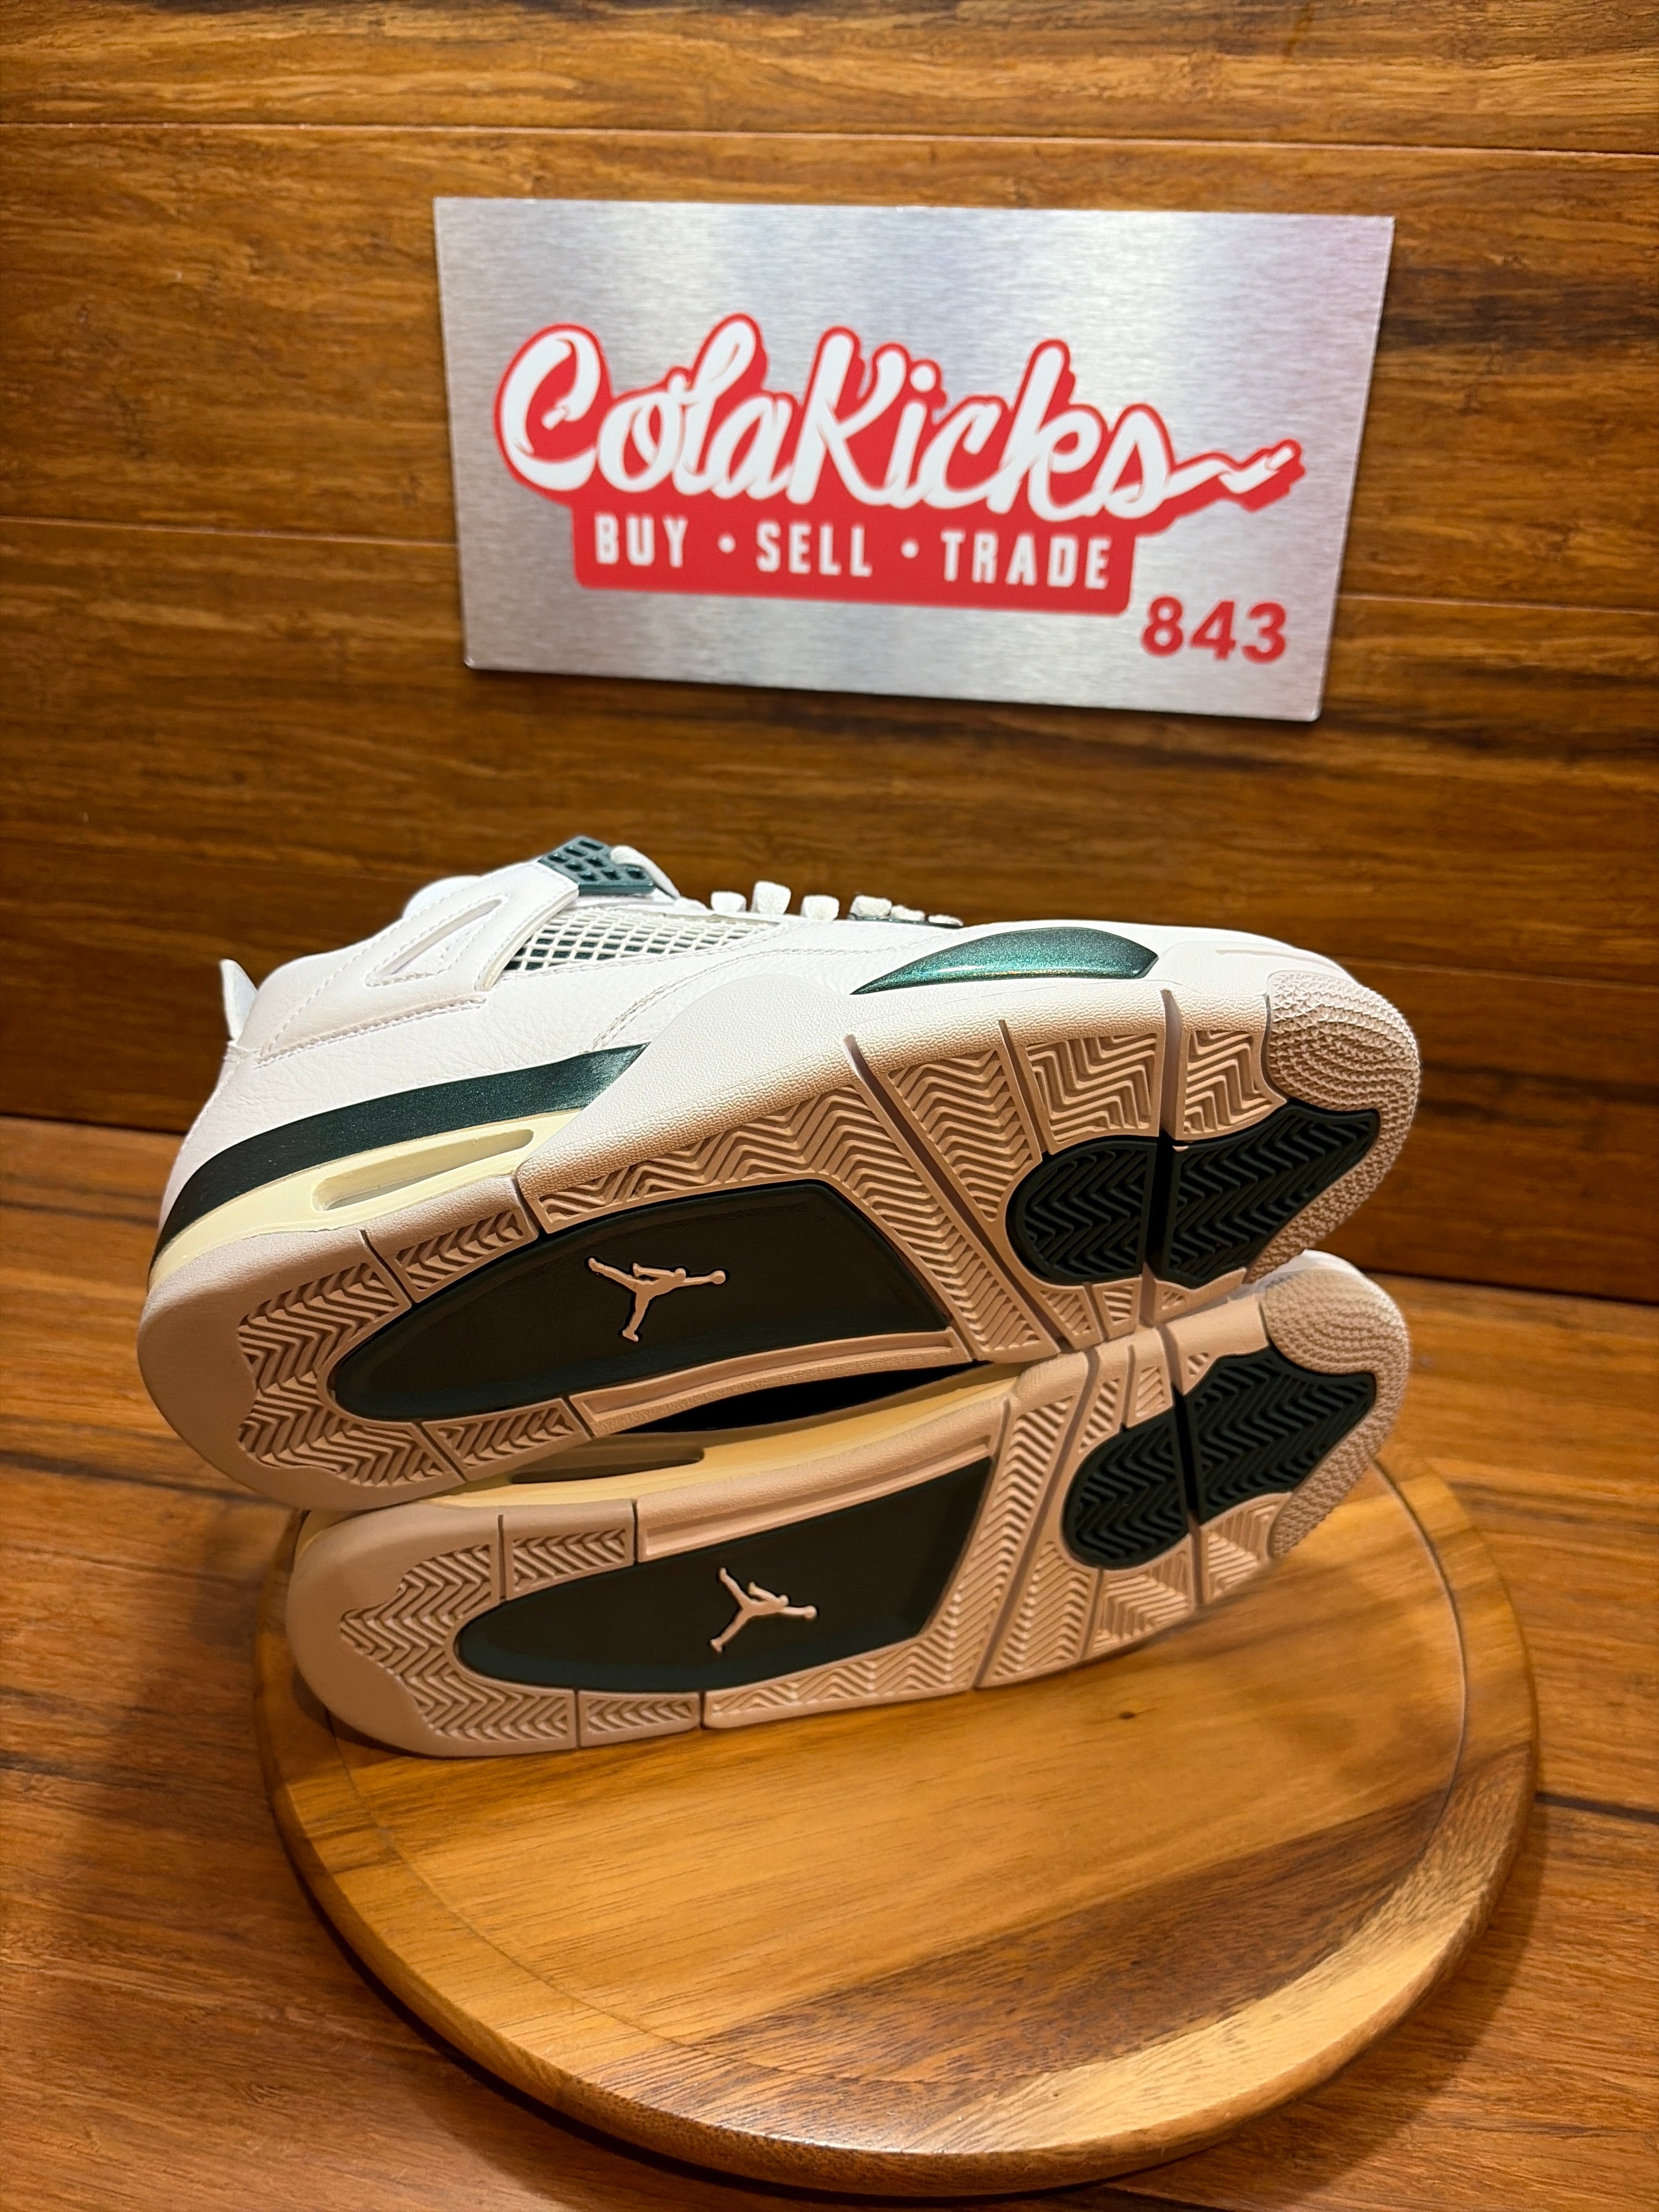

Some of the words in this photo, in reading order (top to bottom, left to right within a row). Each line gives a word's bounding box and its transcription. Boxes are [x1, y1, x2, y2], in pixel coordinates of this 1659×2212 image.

[499, 317, 1296, 522] ColaKicks
[594, 514, 688, 568] BUY
[756, 521, 872, 578] SELL
[940, 529, 1111, 590] TRADE
[1141, 595, 1287, 664] 843
